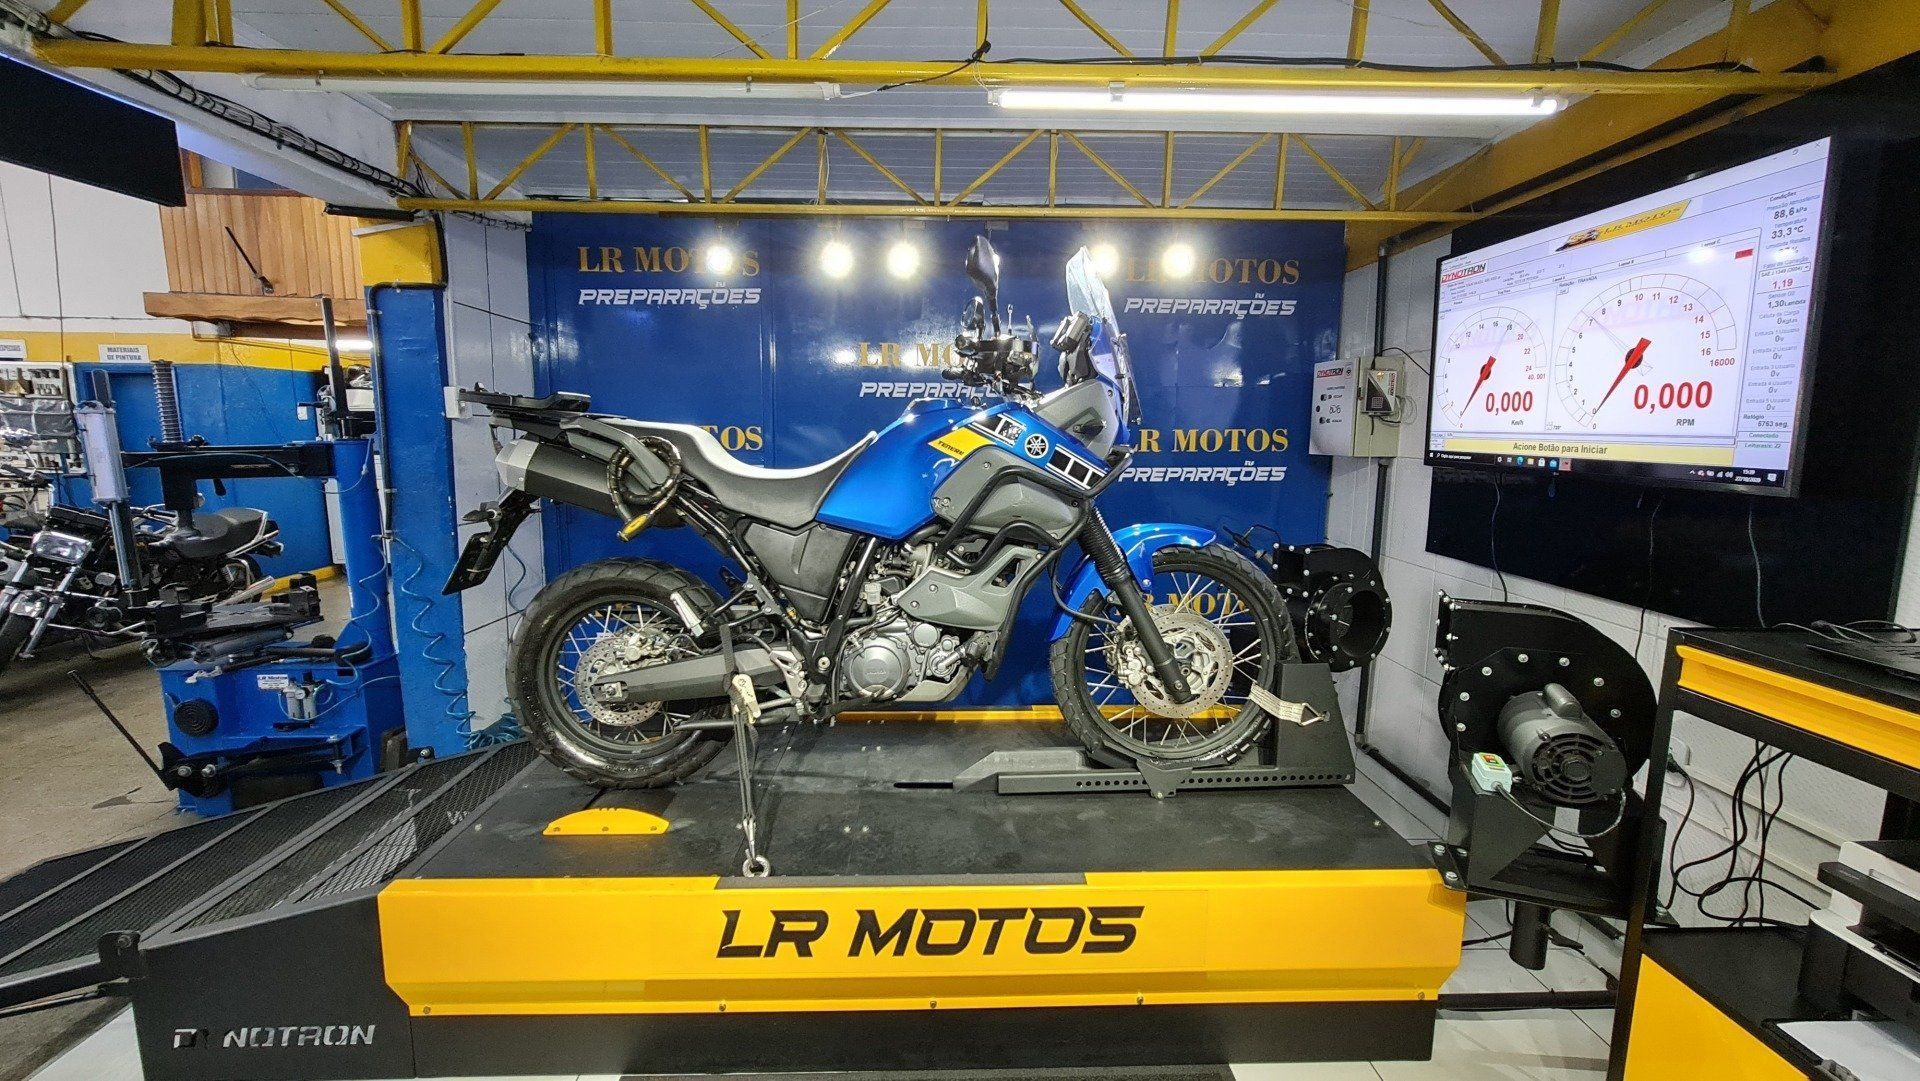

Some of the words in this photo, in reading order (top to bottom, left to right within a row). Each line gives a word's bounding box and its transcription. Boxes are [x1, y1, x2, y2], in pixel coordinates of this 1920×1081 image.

[1774, 207, 1794, 220] 88,6
[1771, 227, 1792, 240] 33,3
[1794, 226, 1804, 234] °C
[578, 246, 626, 273] LR
[633, 246, 760, 277] MOTS
[1442, 262, 1486, 284] DYNOTRON
[1772, 278, 1793, 290] 1,19
[578, 281, 762, 309] PREPARAÇÕES
[1123, 292, 1298, 319] PREPARAÇÕES
[1669, 296, 1678, 304] 12
[1683, 304, 1693, 312] 13
[1694, 315, 1704, 324] 14
[1700, 331, 1710, 339] 15
[858, 342, 900, 367] LR
[1701, 348, 1711, 356] 16
[1710, 358, 1735, 367] 16000
[1486, 390, 1533, 416] 0,000
[1634, 381, 1712, 414] 0,000
[1172, 428, 1289, 453] MOTOS
[1512, 442, 1536, 451] Acione
[1538, 442, 1560, 452] Botão
[1561, 445, 1578, 454] para
[1581, 445, 1608, 454] Iniciar
[1118, 460, 1287, 486] PREPARAÇÕES
[716, 909, 829, 958] LR
[847, 906, 1145, 957] MOTOS
[173, 1024, 376, 1049] DNOTRON
